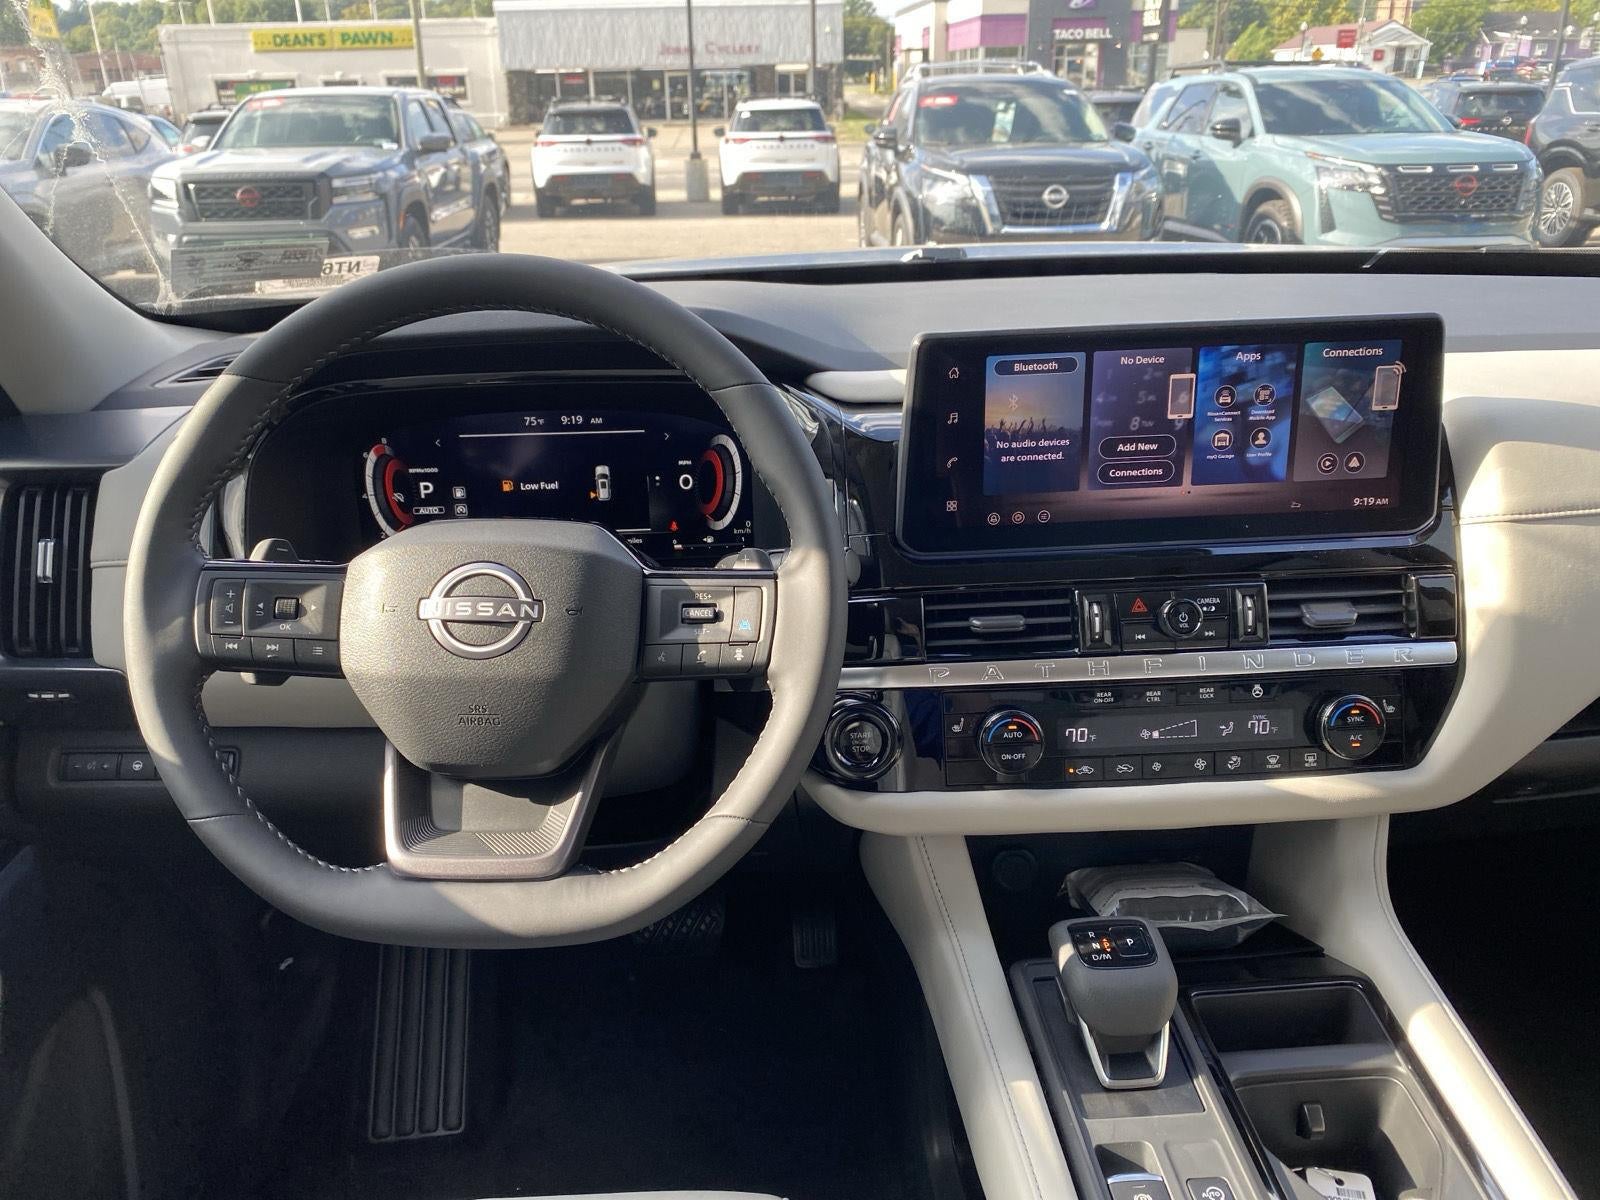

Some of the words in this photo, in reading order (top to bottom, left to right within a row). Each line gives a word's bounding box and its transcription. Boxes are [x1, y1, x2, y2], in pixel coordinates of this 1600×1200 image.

[1053, 28, 1084, 40] TACO
[1085, 27, 1113, 39] BELL
[272, 32, 326, 47] DEAN'S
[341, 32, 393, 45] PAWN
[1236, 351, 1261, 362] Apps
[1323, 347, 1383, 357] Connections
[1120, 356, 1134, 365] No
[1136, 355, 1165, 364] Device
[1014, 361, 1058, 372] Bluetooth
[561, 415, 583, 425] 9:19
[996, 440, 1010, 449] No
[1011, 439, 1036, 448] audio
[1038, 438, 1070, 447] devices
[1117, 443, 1135, 452] Add
[1137, 442, 1158, 451] New
[1000, 454, 1015, 462] are
[1017, 452, 1064, 462] connected.
[1109, 467, 1163, 477] Connections
[419, 481, 434, 499] P
[520, 482, 538, 491] Low
[540, 481, 559, 490] Fuel
[1353, 497, 1374, 506] 9:19
[1196, 597, 1220, 605] CAMERA
[422, 602, 539, 618] NISSAN
[685, 609, 713, 618] CANCEL
[279, 623, 292, 631] OK
[468, 704, 489, 714] SRS
[458, 716, 501, 727] AIRBAG
[1347, 715, 1365, 723] SYNC
[1003, 731, 1023, 739] AUTO
[852, 745, 871, 753] STOP
[1001, 753, 1026, 761] ON-OFF
[1127, 938, 1134, 946] P
[1091, 953, 1112, 961] D/M
